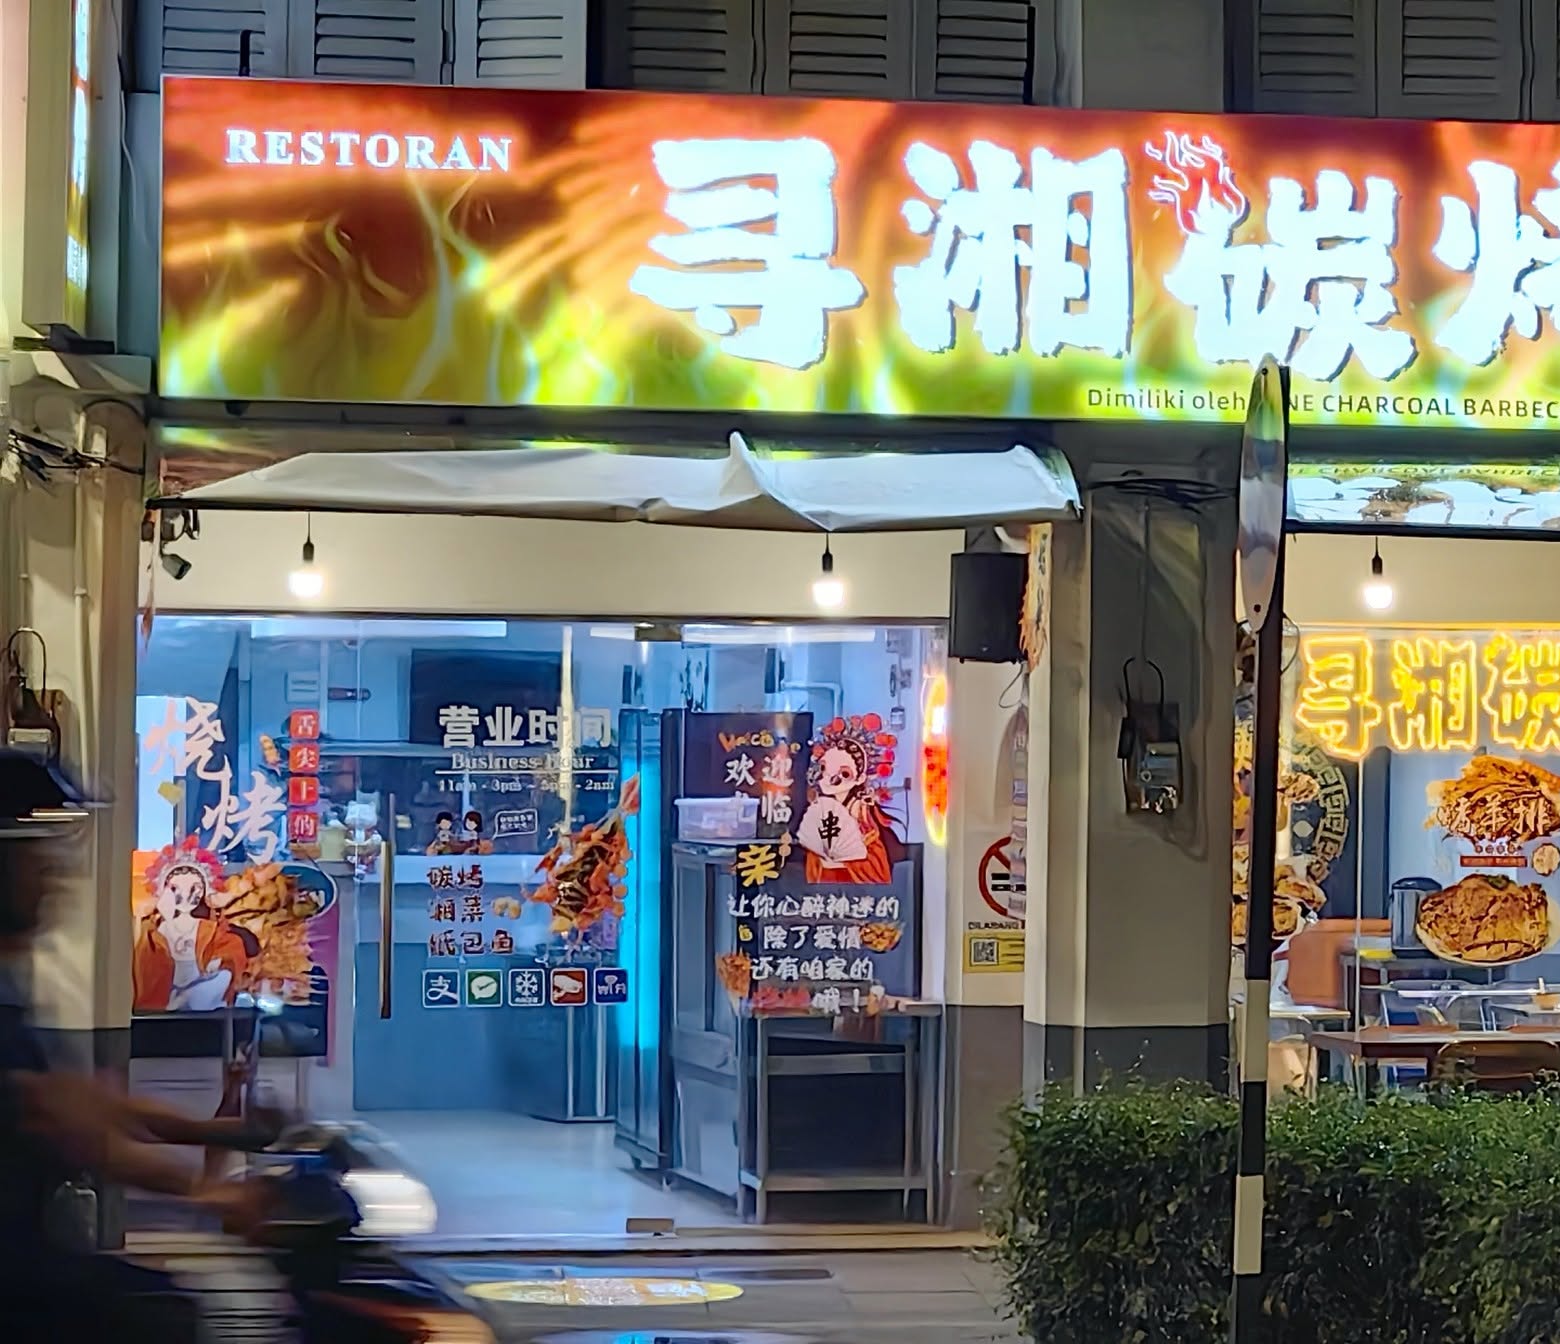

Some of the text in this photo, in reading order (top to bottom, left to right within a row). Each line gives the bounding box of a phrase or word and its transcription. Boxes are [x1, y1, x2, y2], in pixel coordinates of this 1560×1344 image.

[225, 128, 512, 172] RESTORAN
[1087, 388, 1185, 408] Dimiliki
[1192, 390, 1245, 411] oleh
[1322, 394, 1455, 416] CHARCOAL
[438, 704, 612, 748] 营业时间
[451, 752, 539, 770] Business
[724, 753, 794, 787] 欢迎
[818, 810, 841, 849] 串
[737, 845, 780, 888] 亲
[428, 929, 516, 957] 纸包鱼
